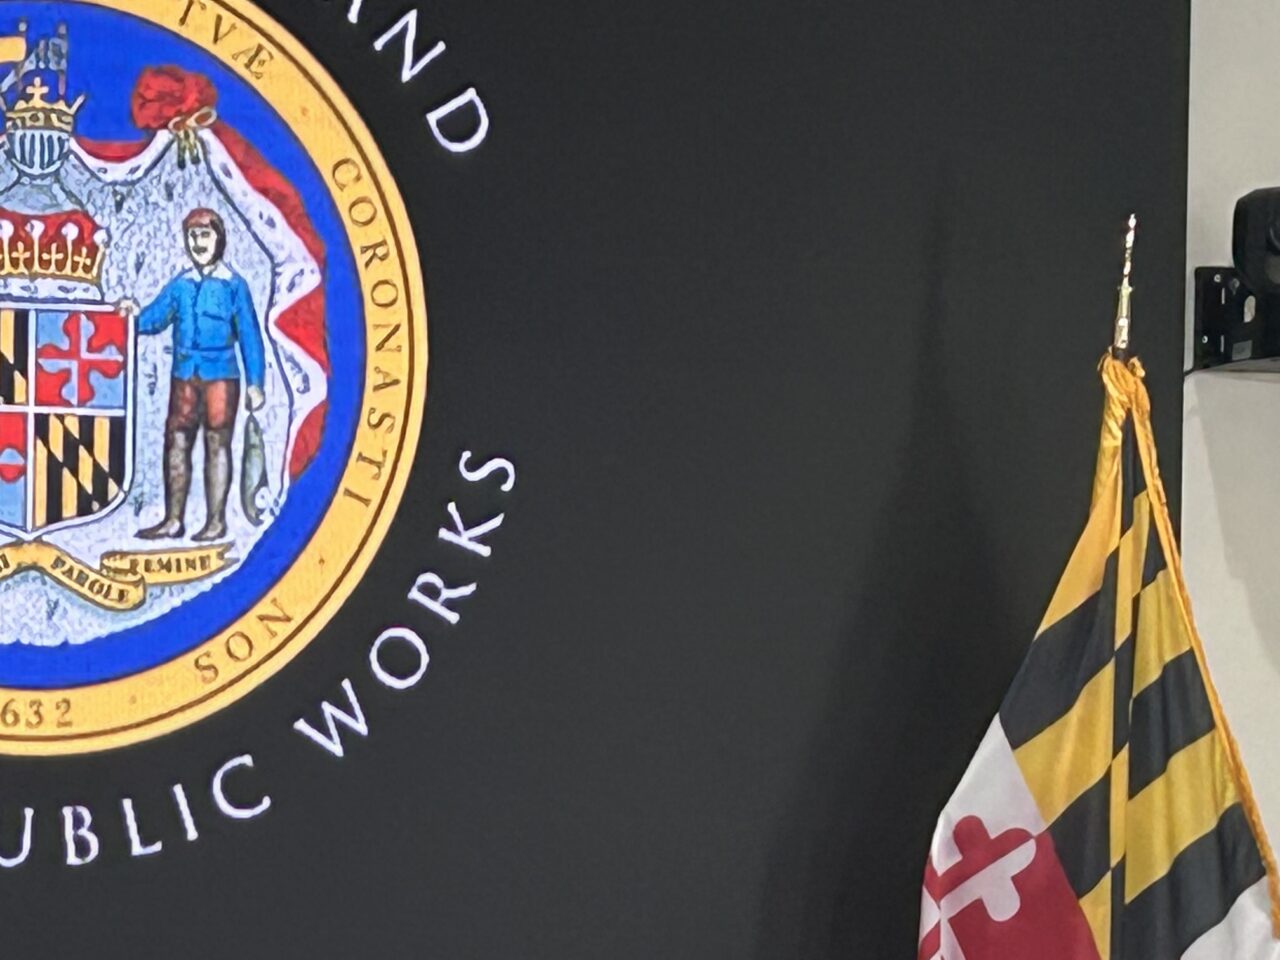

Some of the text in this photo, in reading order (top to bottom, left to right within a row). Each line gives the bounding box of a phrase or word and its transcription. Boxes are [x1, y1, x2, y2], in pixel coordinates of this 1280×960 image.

[346, 0, 490, 153] ND
[331, 157, 403, 508] CORONASTI
[293, 449, 516, 758] WORKS
